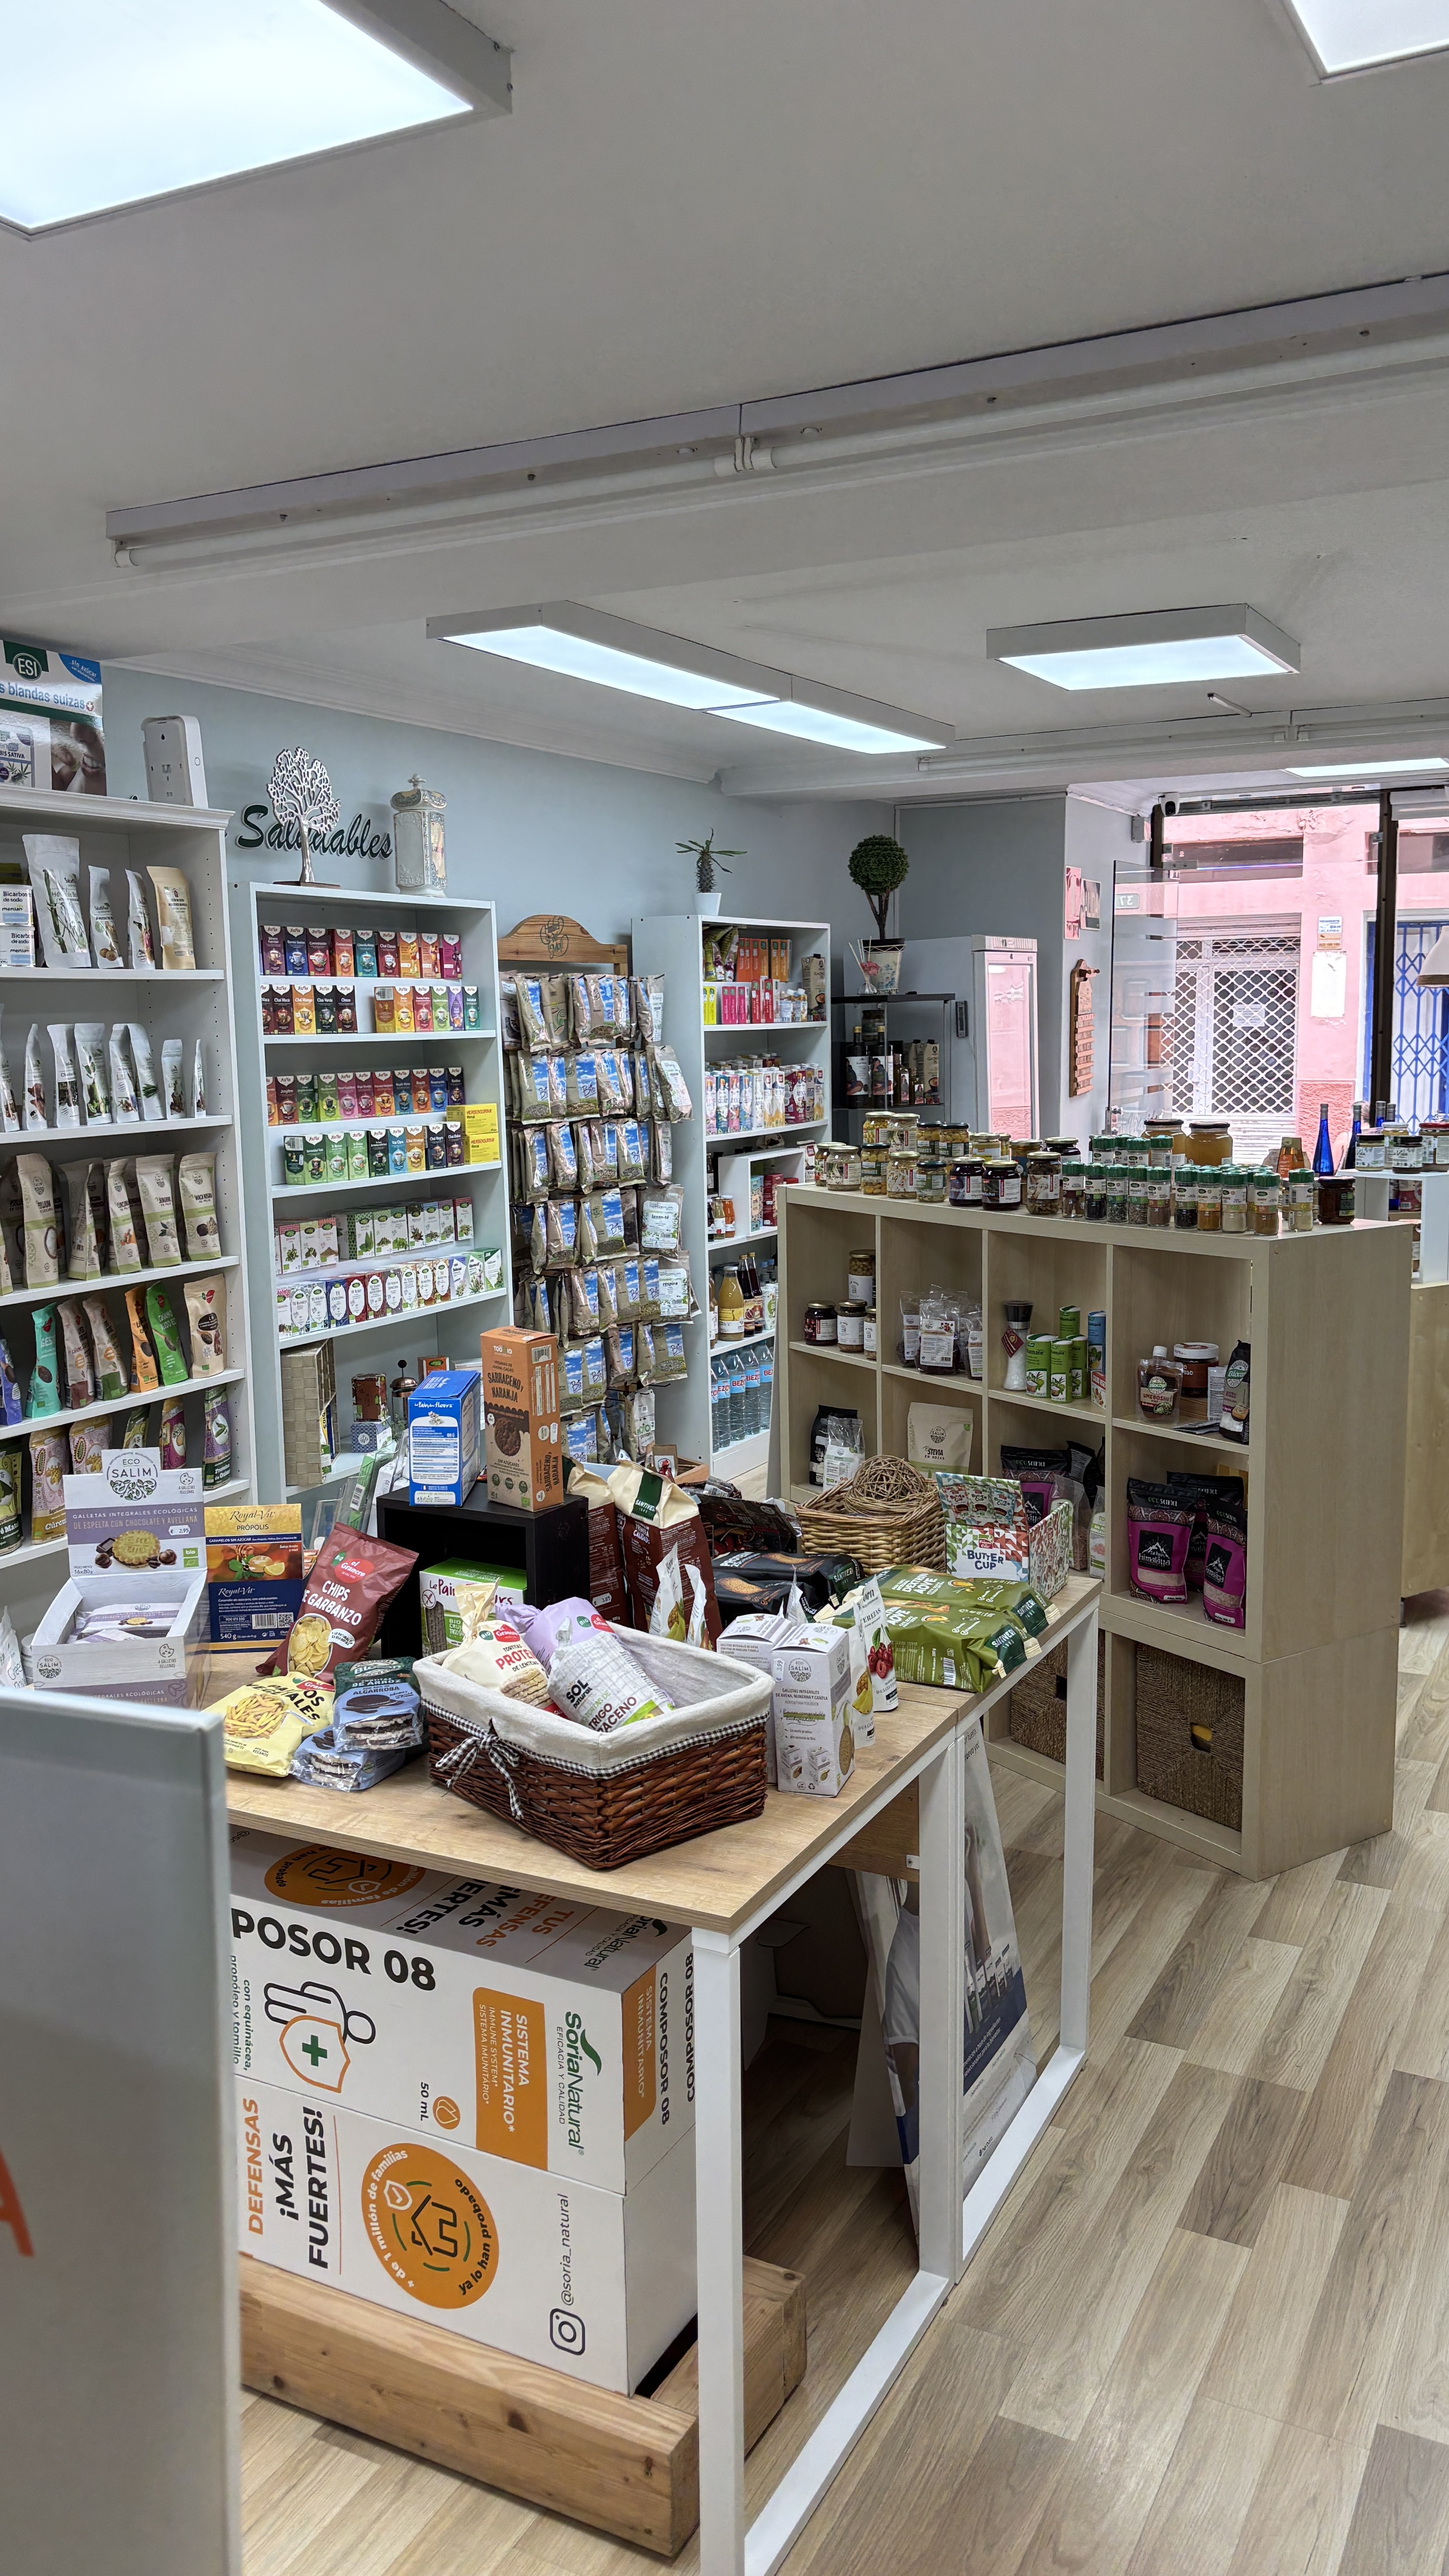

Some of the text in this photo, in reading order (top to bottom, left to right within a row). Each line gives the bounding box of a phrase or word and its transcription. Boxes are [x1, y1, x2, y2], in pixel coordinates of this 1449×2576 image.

[18, 658, 37, 676] ESI
[9, 682, 50, 702] blandas
[53, 694, 85, 709] suizas
[488, 1372, 521, 1389] SARRACENO
[492, 1386, 518, 1403] NARANJA
[1143, 1393, 1169, 1402] UMEBOSHI
[112, 1468, 152, 1478] SALIM
[83, 1521, 109, 1529] ESPELTA
[125, 1518, 160, 1526] CHOCOLATE
[167, 1515, 198, 1524] AVELLANA
[153, 1507, 198, 1515] ECOLÓGICAS
[967, 1550, 1004, 1564] BUTTER
[975, 1560, 996, 1570] CUP
[341, 1563, 366, 1577] Granero
[322, 1580, 350, 1601] CHIPS
[429, 1580, 437, 1590] Le
[913, 1577, 938, 1594] AOVE
[307, 1593, 362, 1626] GARBANZO
[888, 1610, 911, 1625] AOVE
[353, 1686, 400, 1695] ALGARROBA
[566, 1679, 589, 1703] SOL
[573, 1687, 593, 1709] natural
[588, 1703, 612, 1730] TRIGO
[276, 1862, 294, 1887] probado
[321, 1894, 380, 1905] familias
[532, 1910, 575, 1935] TUS
[384, 1950, 436, 1991] 08
[244, 2005, 254, 2071] equinácea,
[685, 1953, 695, 2102] COMPOSOR 08
[233, 2021, 242, 2064] tomillo
[515, 2014, 529, 2086] SISTEMA
[659, 1973, 670, 2124] COMPOSOR 08
[421, 2082, 429, 2098] 50
[242, 2098, 263, 2235] DEFENSAS
[269, 2132, 298, 2221] ¡MÁS
[372, 2150, 408, 2181] familias
[303, 2106, 328, 2268] FUERTES!
[368, 2183, 377, 2199] de
[368, 2203, 386, 2249] millón
[455, 2179, 492, 2295] ya lo han probado
[558, 2194, 575, 2306] @soria_natural
[391, 2262, 406, 2278] de
